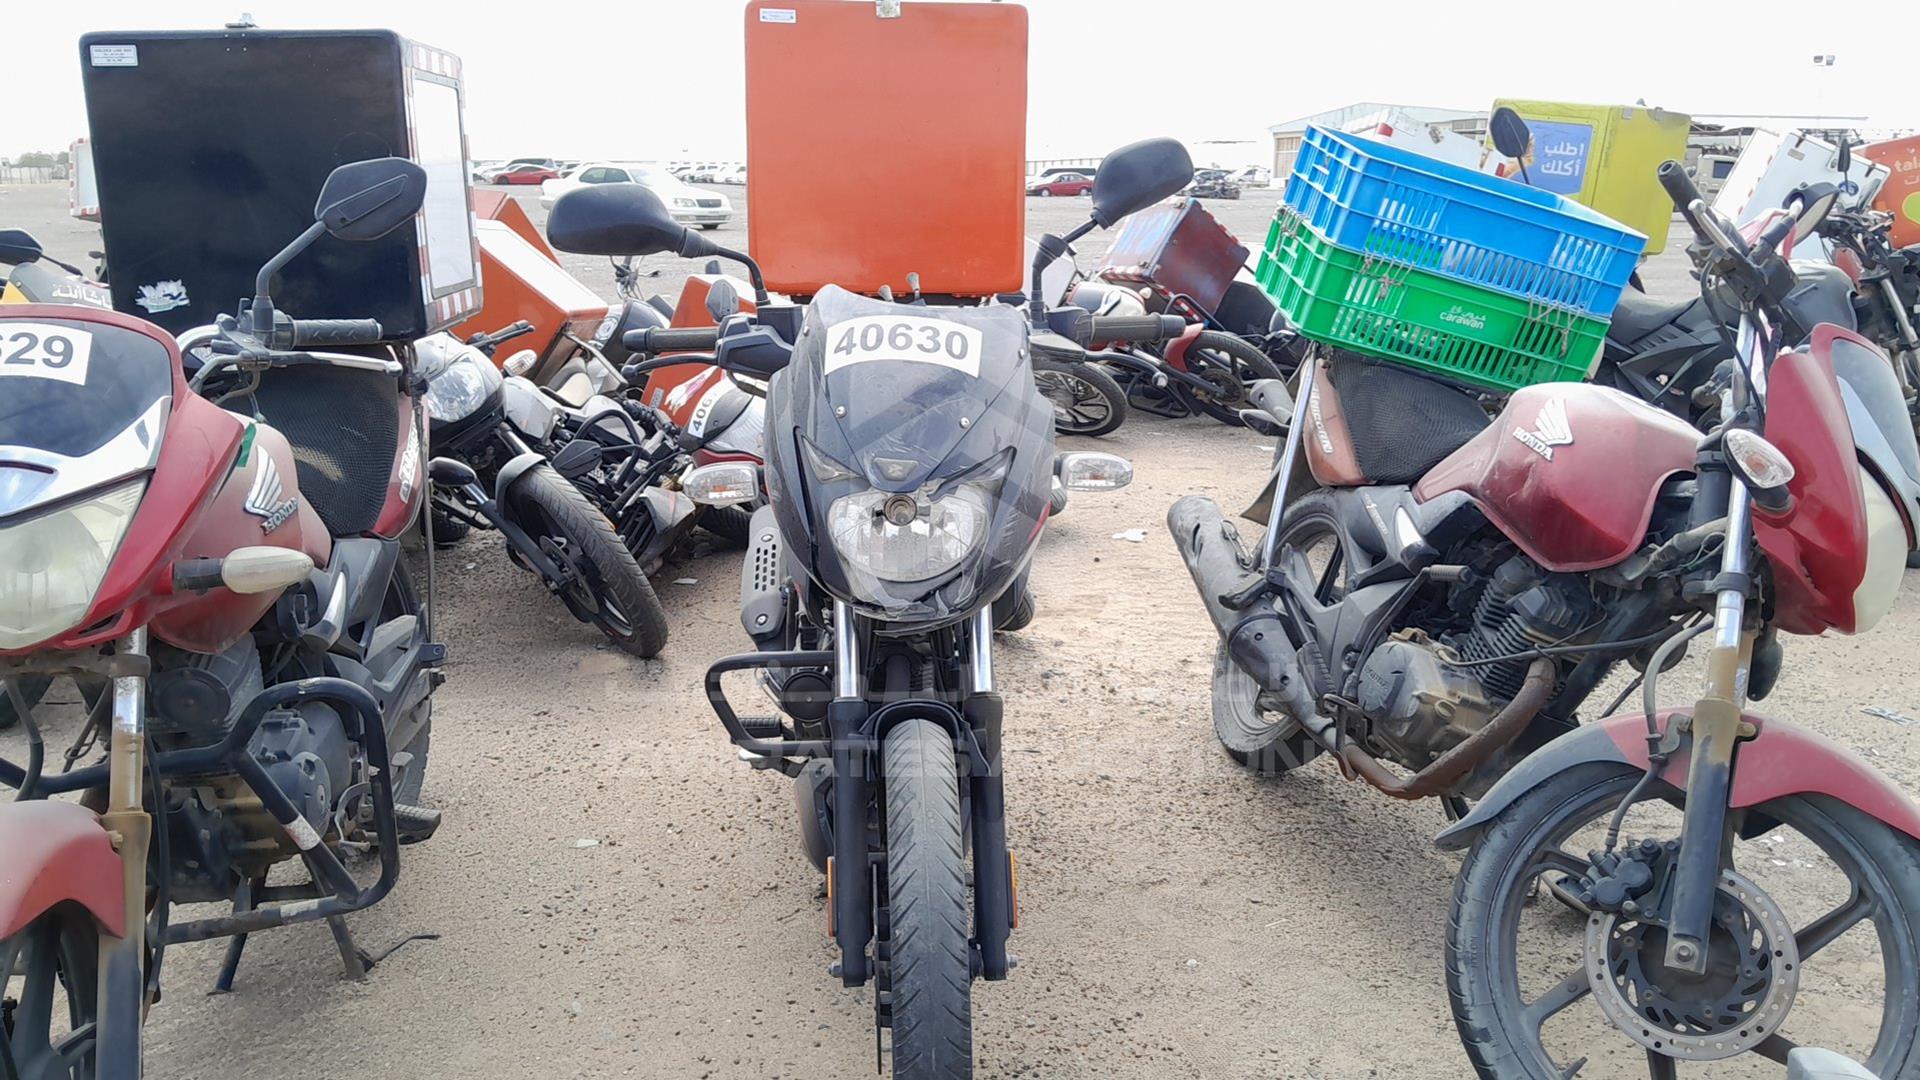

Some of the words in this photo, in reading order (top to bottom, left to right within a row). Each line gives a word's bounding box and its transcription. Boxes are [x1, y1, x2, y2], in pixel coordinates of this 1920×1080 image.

[1544, 141, 1585, 157] اطلب
[1439, 311, 1484, 329] carawan
[0, 332, 74, 369] 29
[834, 323, 968, 360] 40630
[1512, 426, 1553, 461] HONDA
